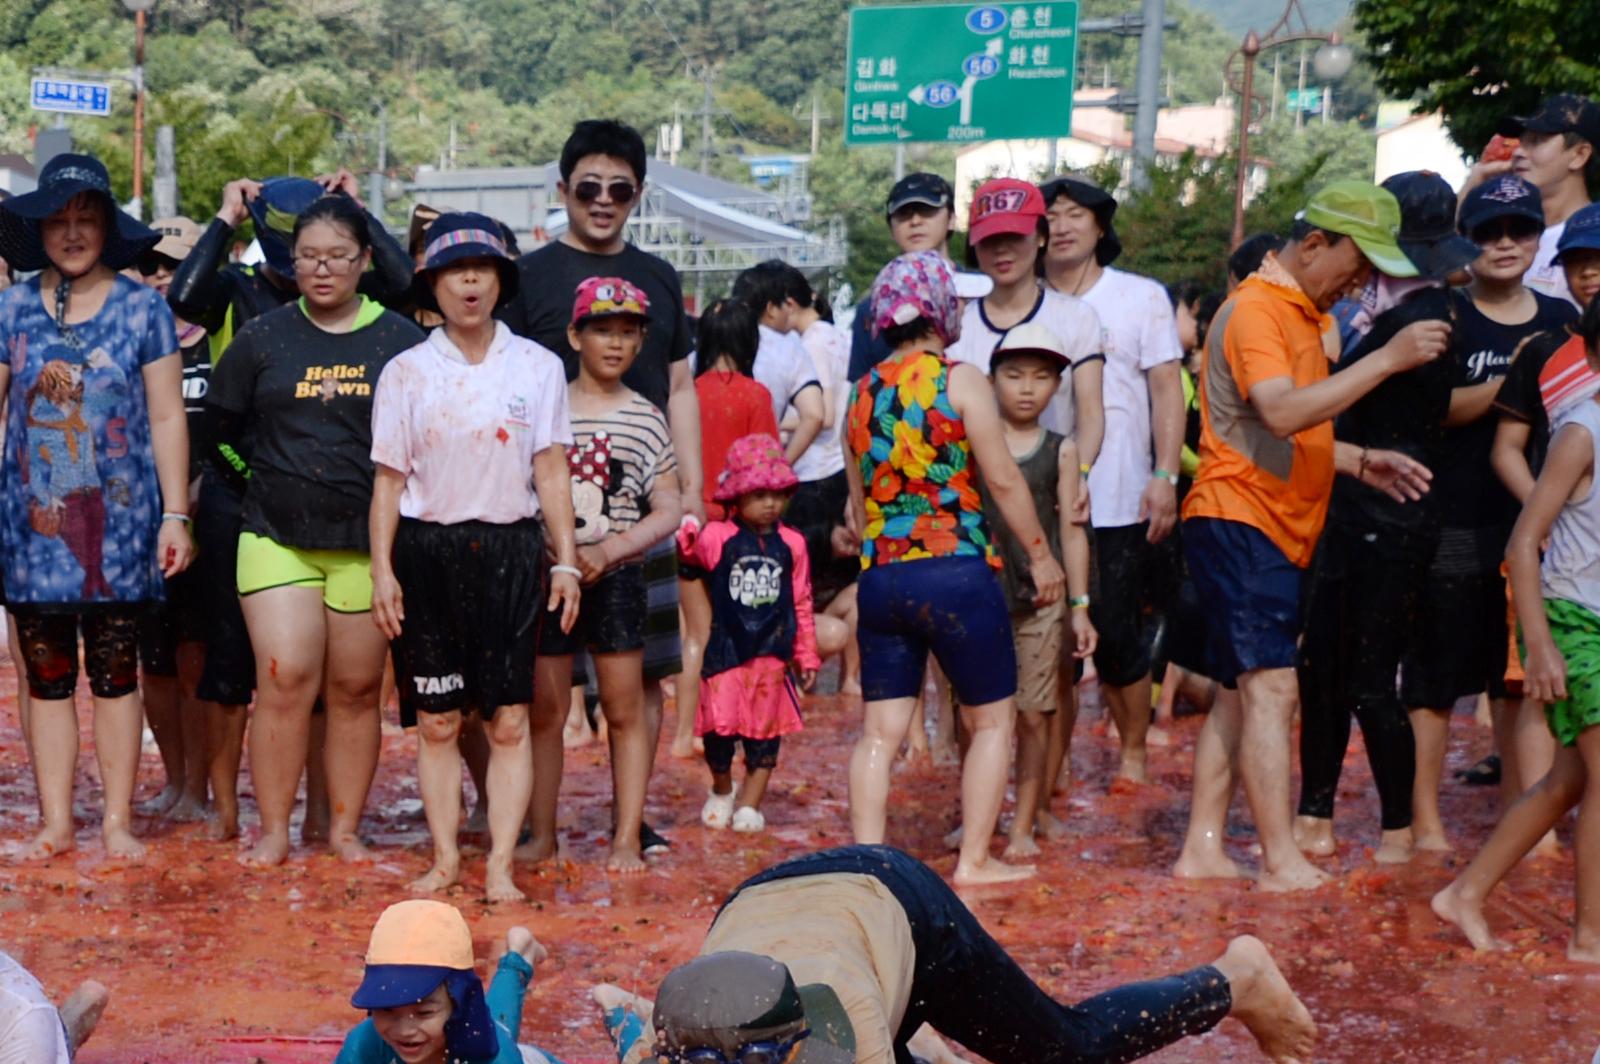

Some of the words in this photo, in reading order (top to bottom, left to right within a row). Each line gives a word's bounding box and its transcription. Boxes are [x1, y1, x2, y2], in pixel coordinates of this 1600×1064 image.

[980, 11, 993, 28] 5
[969, 59, 994, 74] 56
[930, 88, 952, 103] 56
[947, 127, 986, 140] 200m
[304, 365, 366, 381] Hello!
[294, 382, 371, 400] Brwn
